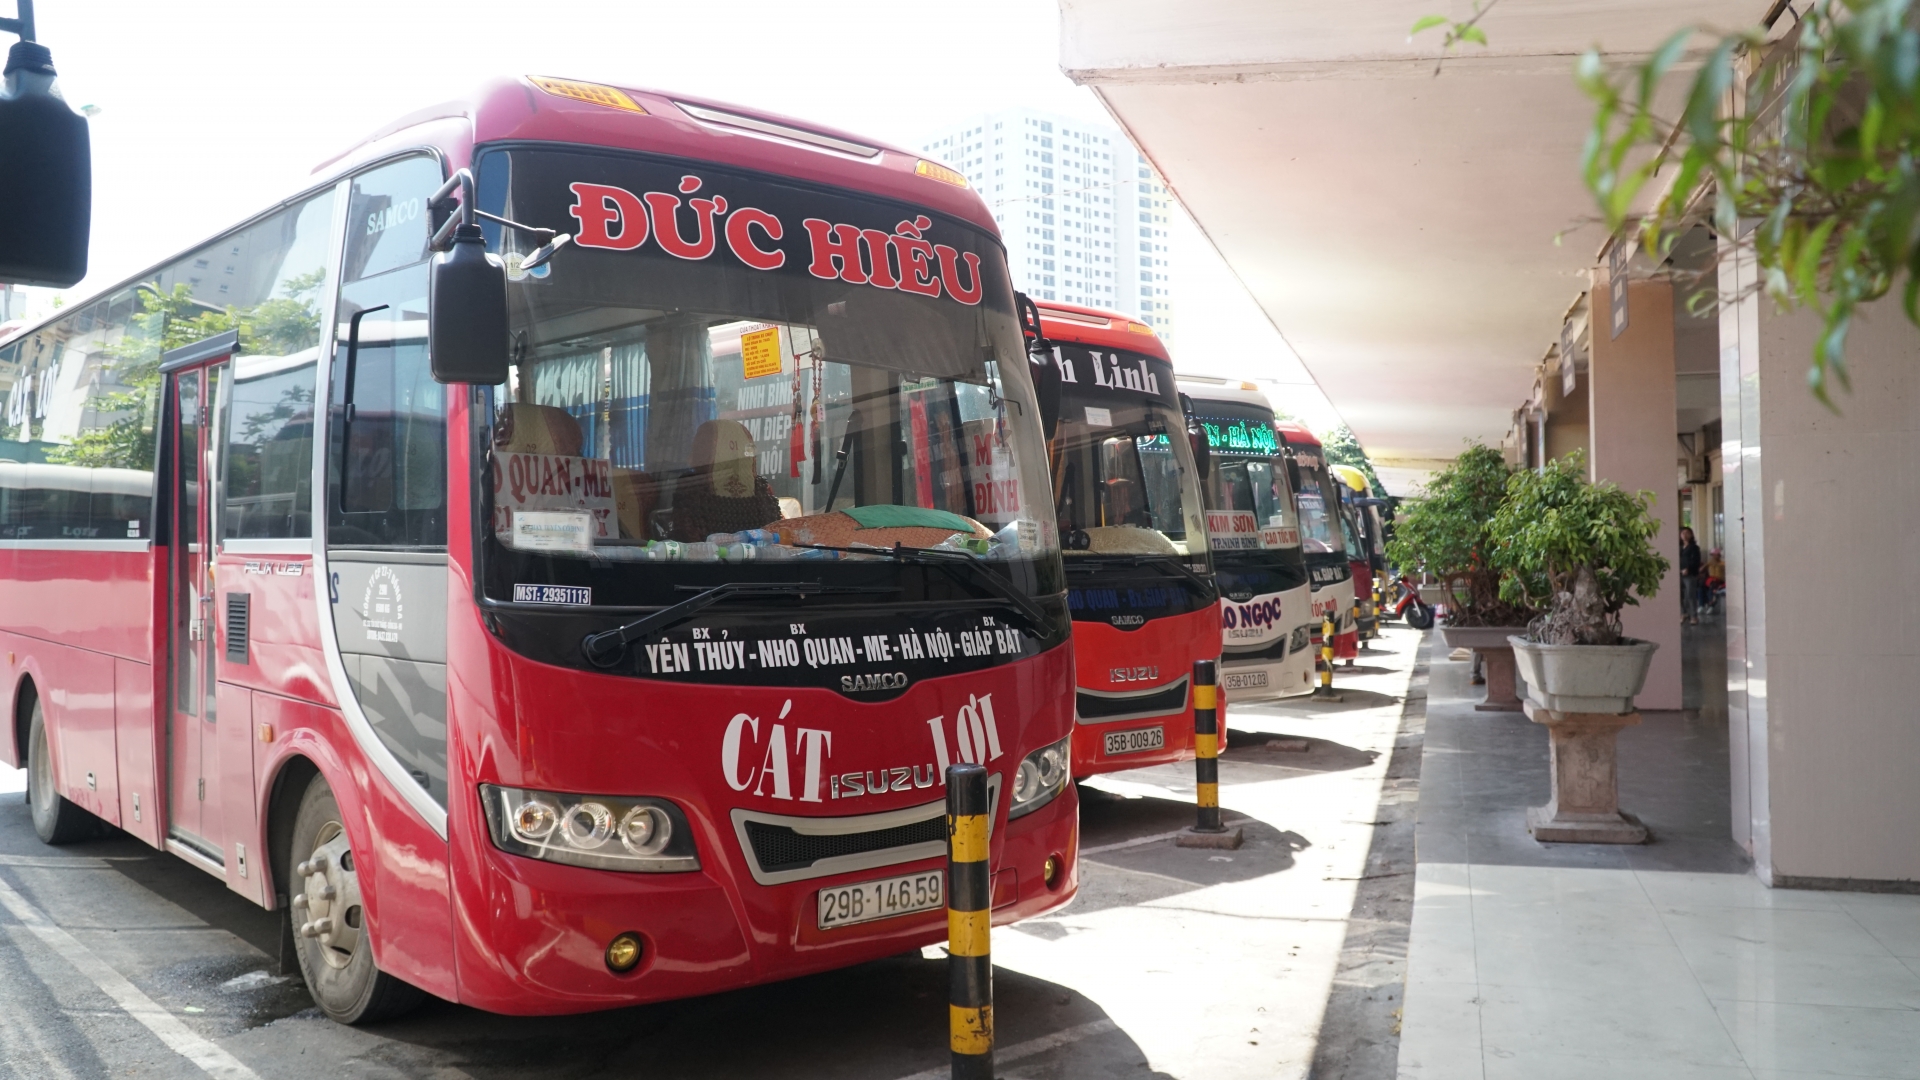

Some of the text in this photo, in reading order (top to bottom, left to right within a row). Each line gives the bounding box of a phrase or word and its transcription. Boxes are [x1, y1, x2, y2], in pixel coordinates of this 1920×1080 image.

[366, 197, 419, 235] SAMCO
[569, 175, 983, 305] ĐỨC HIẾU
[1089, 351, 1161, 395] Linh
[737, 385, 766, 411] NINH
[738, 418, 761, 441] AM
[763, 412, 792, 444] ĐIỆP
[1228, 421, 1251, 448] HÀ
[1251, 423, 1277, 454] NỘI
[509, 454, 571, 503] QUAN
[581, 459, 612, 498] ME
[760, 446, 783, 479] NỘI
[975, 473, 1020, 514] ĐÌNH
[1208, 514, 1256, 533] KIM SƠN
[516, 586, 589, 604] MST: 29351113
[1069, 588, 1084, 610] HO
[789, 623, 807, 635] BX
[982, 616, 996, 627] BX
[1111, 615, 1145, 625] SAMCO
[1222, 598, 1281, 630] O NGỌC
[645, 637, 691, 674] YÊN
[995, 624, 1022, 655] BÁT
[692, 628, 711, 640] BX
[1228, 628, 1264, 639] ISUZU
[840, 672, 909, 693] SAMCO
[1109, 665, 1159, 683] ISUZU
[721, 698, 832, 803] CÁT
[1107, 729, 1162, 752] 35B-009.26
[830, 763, 934, 800] ISUZU
[823, 875, 940, 923] 29B-146.59
